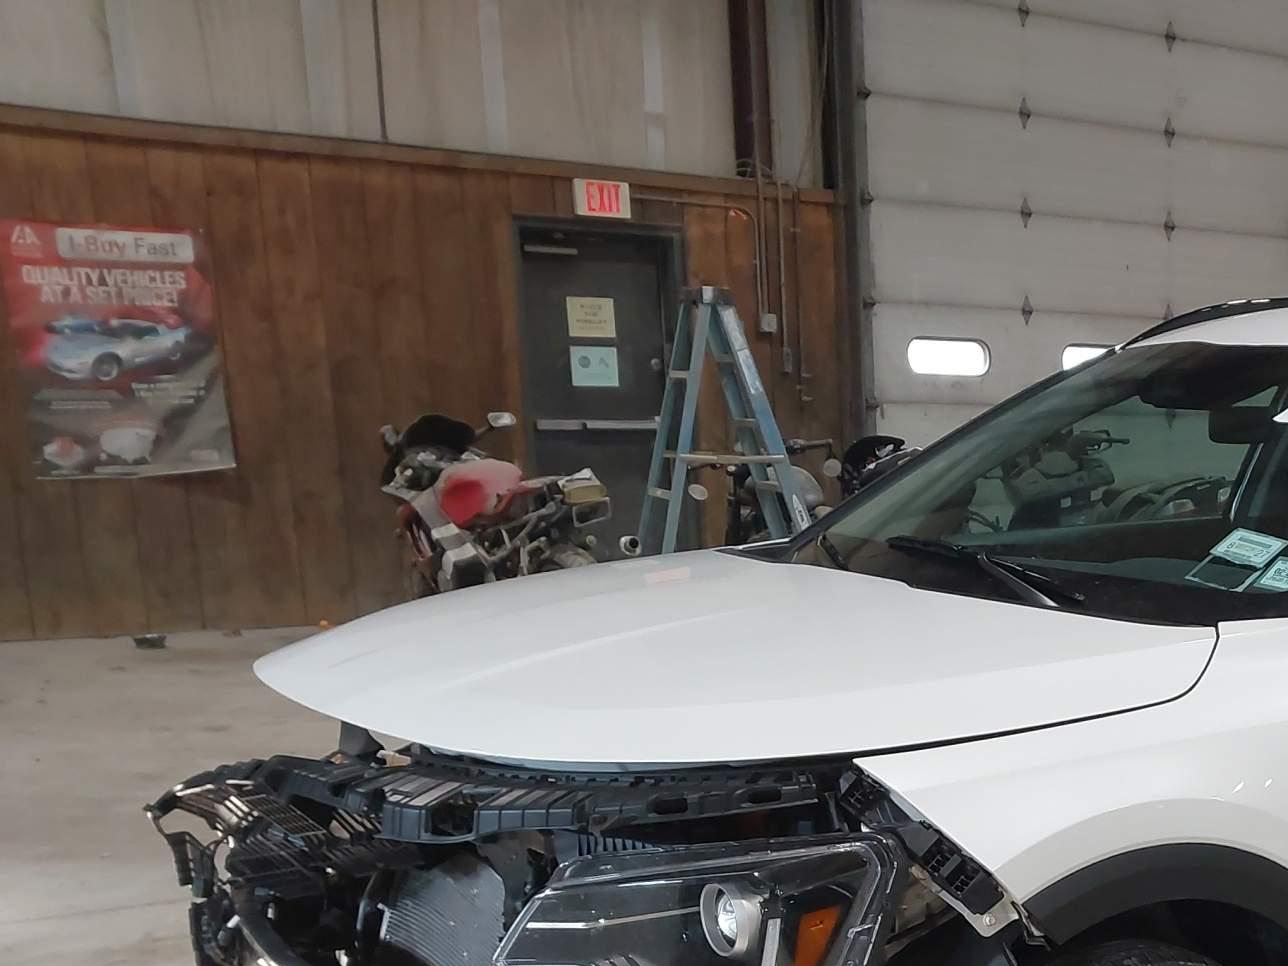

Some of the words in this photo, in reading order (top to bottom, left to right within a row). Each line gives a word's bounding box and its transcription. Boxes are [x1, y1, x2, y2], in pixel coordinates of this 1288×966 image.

[586, 181, 621, 213] EXIT
[68, 235, 126, 257] I-Buy
[134, 237, 177, 256] Fast
[22, 265, 100, 287] QUALITY
[104, 268, 187, 289] VEHICLES
[41, 285, 63, 304] AT
[70, 286, 82, 304] A
[86, 287, 121, 305] SET
